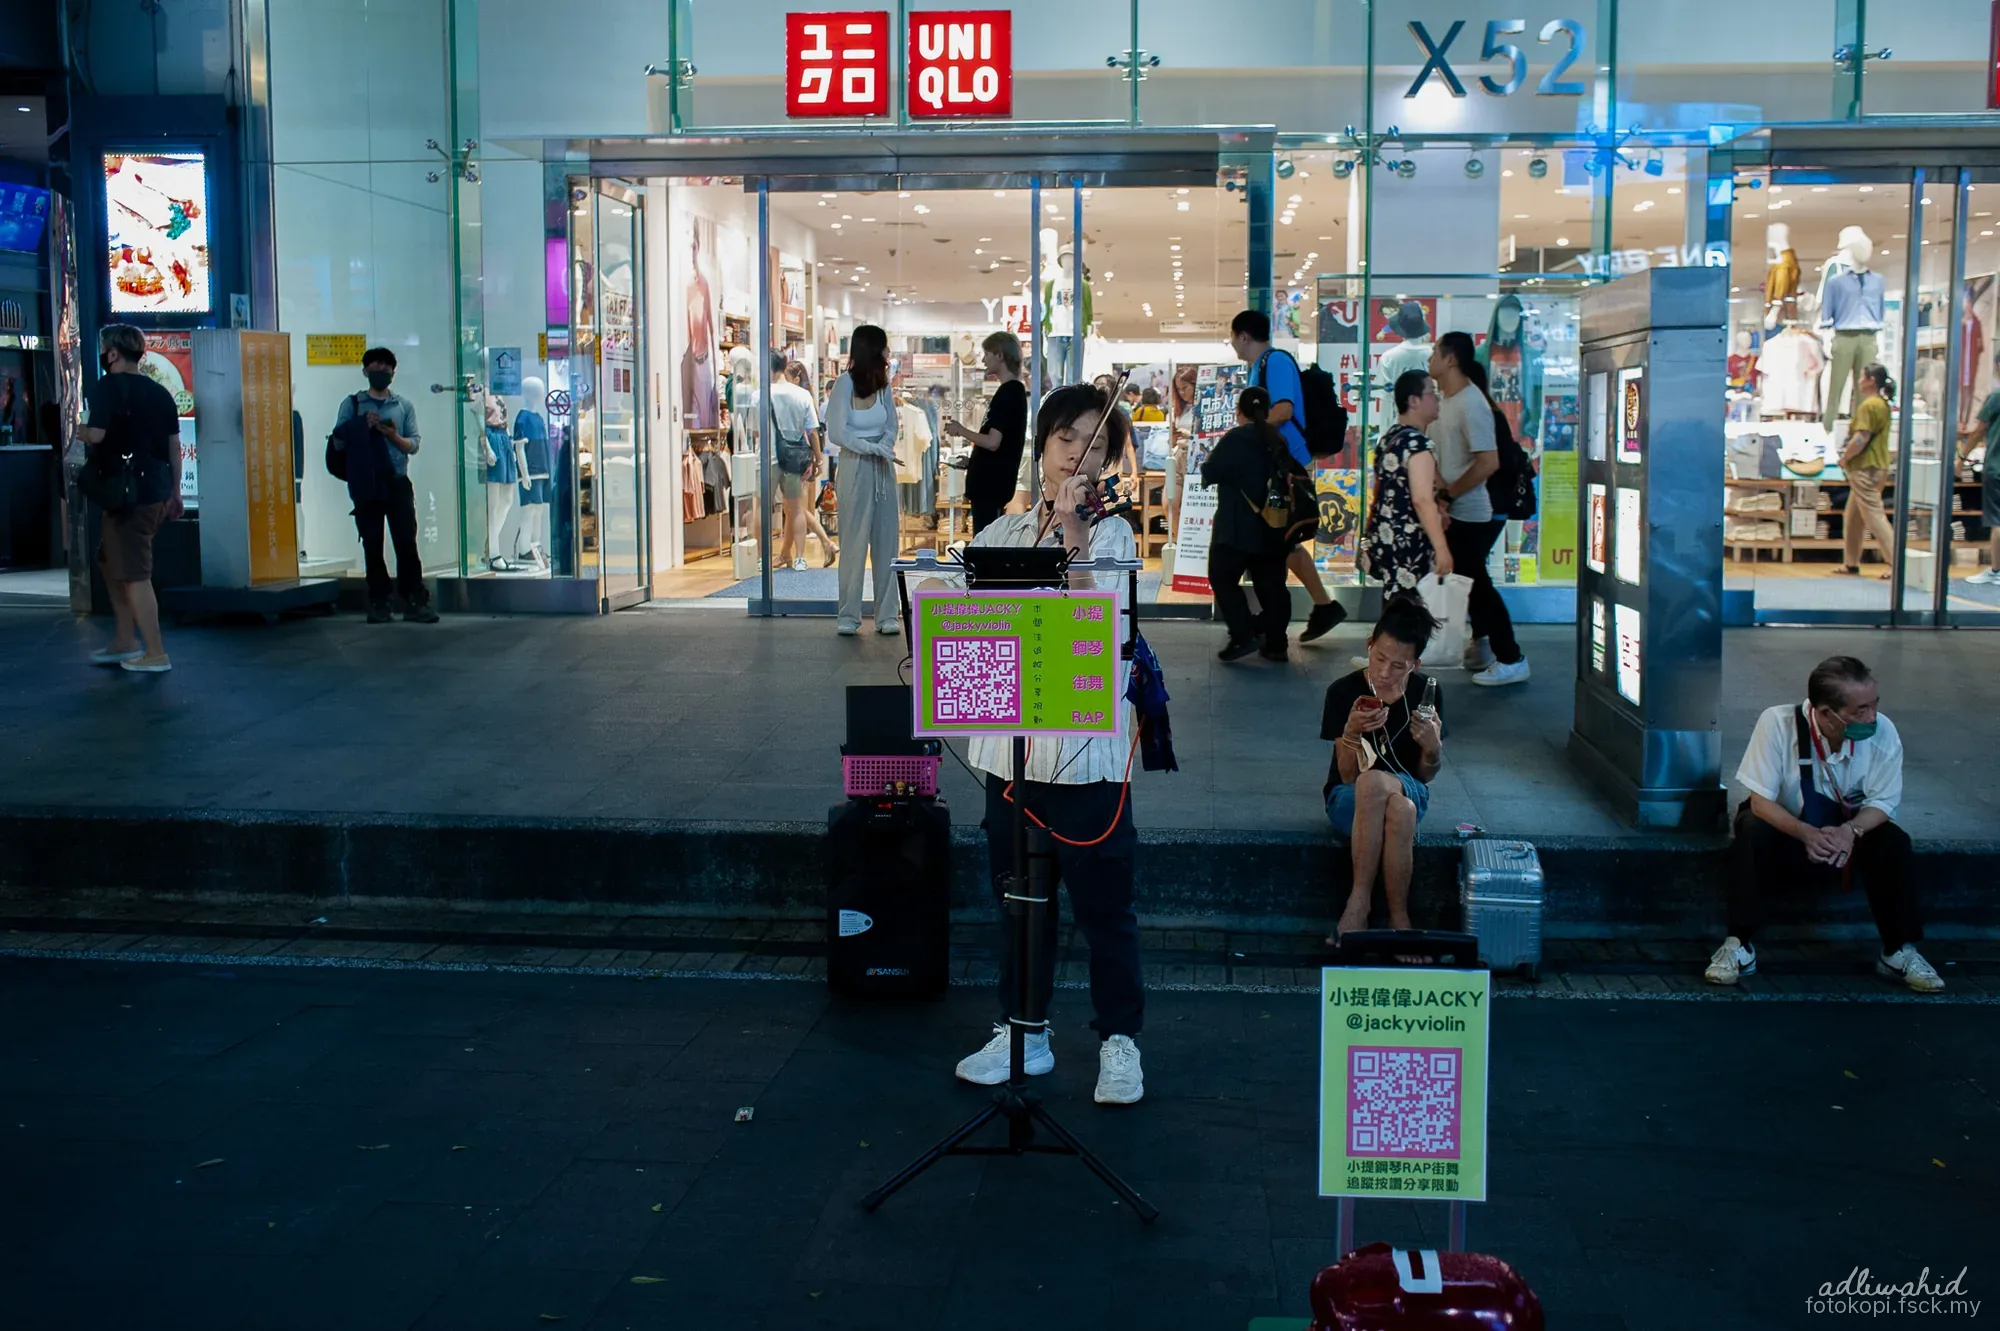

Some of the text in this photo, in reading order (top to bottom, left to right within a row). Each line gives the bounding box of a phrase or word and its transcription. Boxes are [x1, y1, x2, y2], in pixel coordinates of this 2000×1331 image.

[800, 24, 875, 60] ユニ
[919, 23, 992, 60] UNI
[1403, 18, 1587, 98] X52
[797, 67, 875, 103] クロ
[919, 65, 999, 109] QLO
[20, 335, 39, 350] VIP
[1552, 548, 1574, 565] UT
[931, 602, 1022, 616] 小提偉偉JACKY
[1072, 604, 1104, 621] 小提
[941, 619, 1012, 632] @jackyviolin
[1072, 639, 1104, 656] 鋼琴
[1072, 674, 1104, 691] 街舞
[1071, 710, 1105, 724] RAP
[1329, 986, 1484, 1009] 小提偉偉JACKY
[1346, 1013, 1466, 1034] @jackyviolin
[1347, 1159, 1460, 1176] 小提鋼琴RAP街舞
